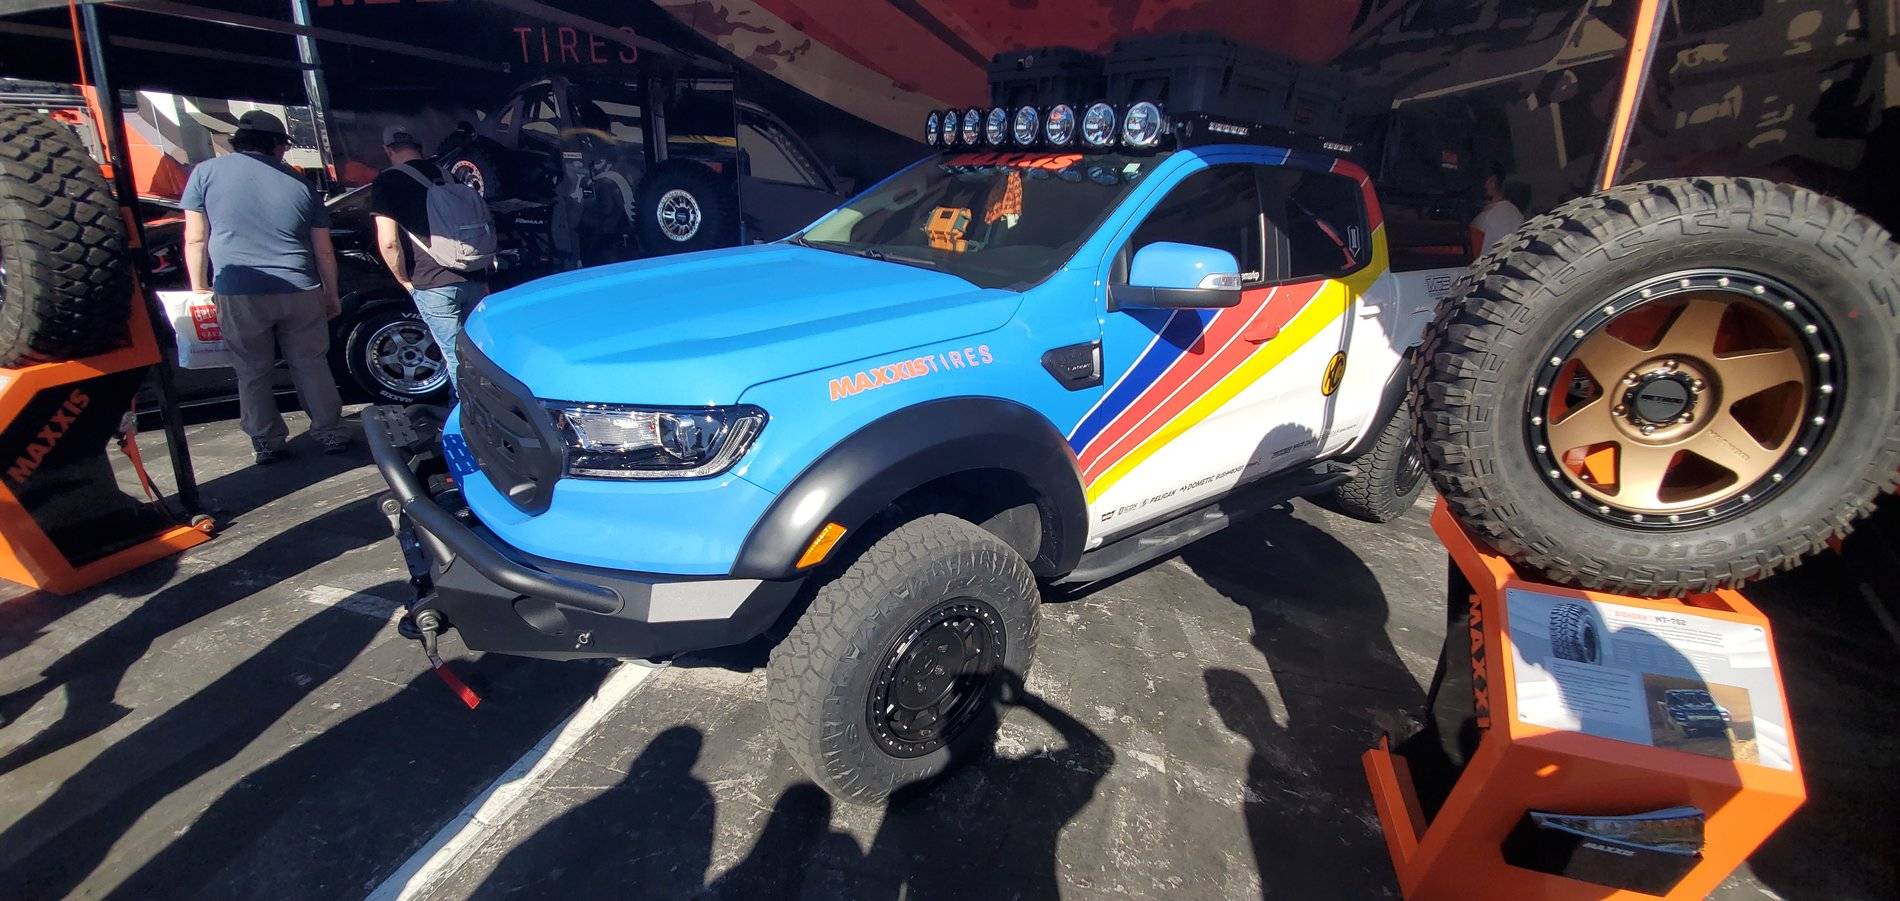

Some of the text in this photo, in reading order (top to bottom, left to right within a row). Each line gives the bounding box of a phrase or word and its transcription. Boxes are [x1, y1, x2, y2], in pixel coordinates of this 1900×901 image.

[513, 26, 638, 64] TIRES
[829, 345, 993, 401] MAXXIS TIRES
[7, 388, 89, 484] MAXXIS
